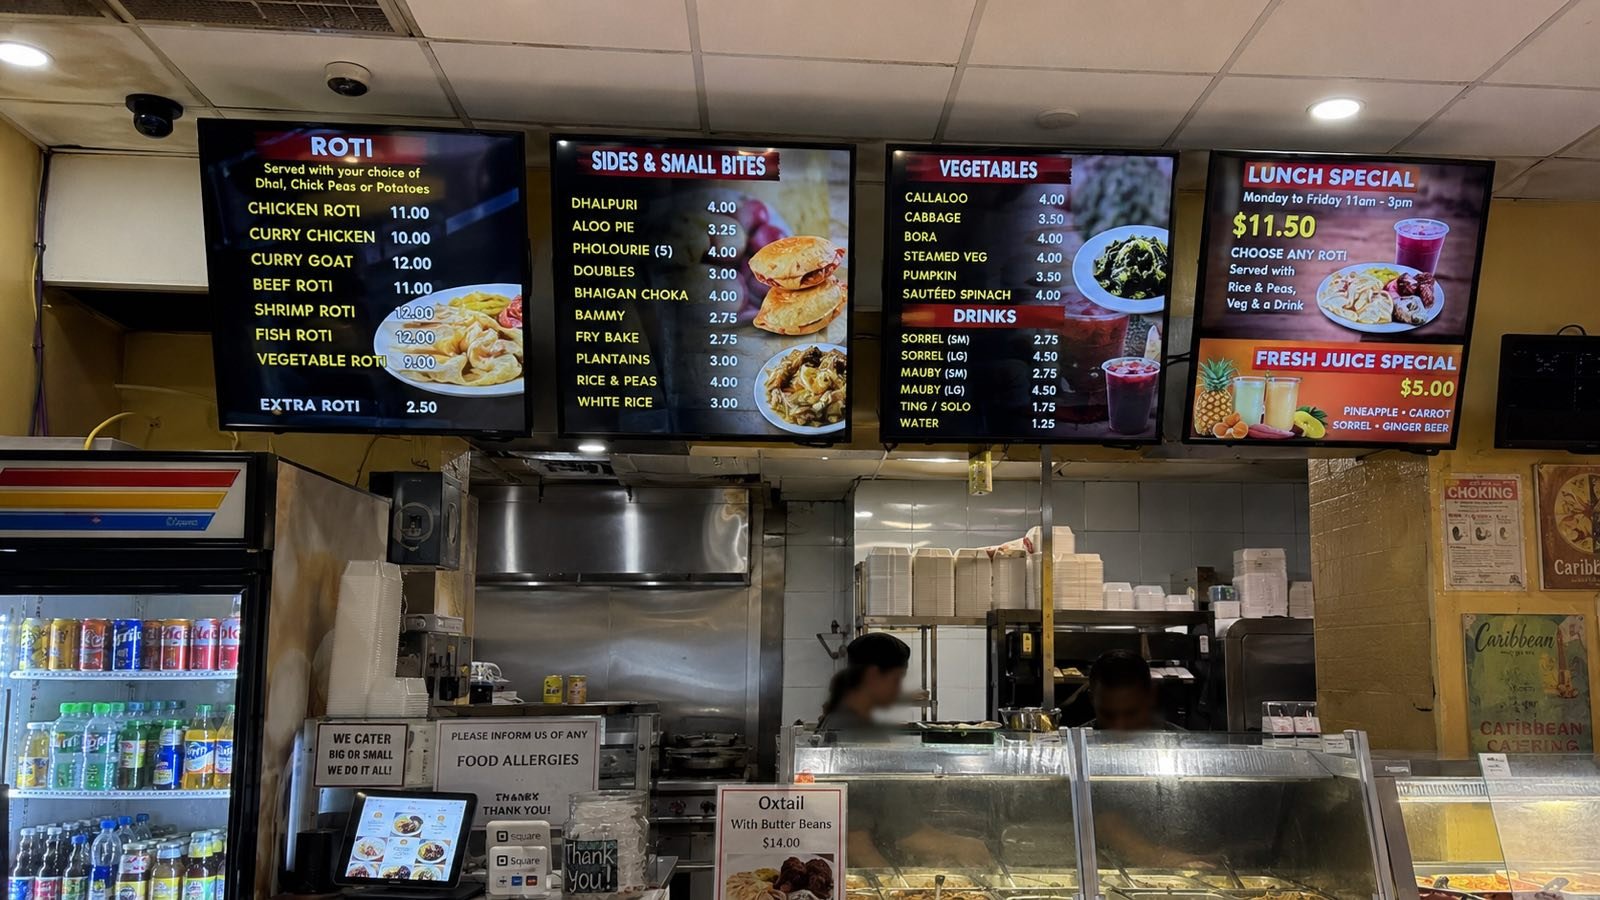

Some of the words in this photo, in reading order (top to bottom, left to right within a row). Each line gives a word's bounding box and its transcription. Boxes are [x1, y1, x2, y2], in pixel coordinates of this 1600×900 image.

[311, 136, 373, 157] ROTI
[591, 150, 638, 171] SIDES
[661, 153, 716, 175] SMALL
[721, 155, 766, 176] BITES
[939, 159, 1038, 179] VEGETABLES
[264, 163, 305, 175] Served
[309, 163, 334, 175] with
[337, 166, 364, 178] your
[367, 165, 405, 178] choice
[408, 166, 420, 178] of
[1248, 166, 1322, 185] LUNCH
[1328, 168, 1415, 187] SPECIAL
[255, 178, 287, 191] Dhal,
[290, 178, 324, 191] Chick
[328, 179, 356, 192] Peas
[360, 182, 373, 192] or
[377, 181, 430, 194] Potatoes
[571, 197, 638, 210] DHALPURI
[707, 201, 736, 213] 4.00
[905, 191, 968, 203] CALLALOO
[1039, 193, 1065, 205] 4.00
[1243, 192, 1288, 205] Monday
[1291, 193, 1304, 204] to
[1307, 193, 1342, 207] Friday
[1346, 195, 1376, 207] 11am
[1388, 196, 1413, 208] 3pm
[248, 201, 318, 216] CHICKEN
[323, 203, 361, 218] ROTI
[390, 205, 430, 220] 11.00
[904, 211, 961, 223] CABBAGE
[1038, 213, 1064, 224] 3.50
[572, 220, 611, 232] ALOO
[615, 221, 635, 232] PIE
[708, 224, 736, 235] 3.25
[1232, 211, 1316, 238] $11.50
[249, 227, 301, 242] CURRY
[307, 228, 376, 243] CHICKEN
[391, 231, 431, 245] 10.00
[904, 231, 937, 242] BORA
[1037, 233, 1063, 244] 4.00
[573, 242, 650, 256] PHOLOURIE
[654, 245, 673, 259] (5)
[708, 246, 737, 258] 4.00
[904, 250, 960, 262] STEAMED
[963, 251, 988, 262] VEG
[1036, 252, 1063, 263] 4.00
[1231, 247, 1283, 259] CHOOSE
[1287, 248, 1315, 260] ANY
[1318, 249, 1346, 261] ROTI
[251, 253, 303, 267] CURRY
[308, 254, 354, 268] GOAT
[392, 256, 432, 270] 12.00
[574, 265, 635, 277] DOUBLES
[708, 268, 737, 279] 3.00
[903, 270, 957, 281] PUMPKIN
[1036, 271, 1062, 282] 3.50
[1229, 264, 1268, 275] Served
[1271, 265, 1295, 276] with
[253, 278, 291, 291] BEEF
[296, 279, 333, 292] ROTI
[394, 281, 433, 295] 11.00
[902, 285, 956, 300] SAUTÉED
[960, 289, 1011, 300] SPINACH
[1035, 290, 1061, 300] 4.00
[1228, 282, 1251, 293] Rice
[1266, 283, 1297, 295] Peas,
[574, 287, 637, 299] BHAIGAN
[641, 289, 689, 301] CHOKA
[709, 290, 737, 302] 4.00
[254, 303, 314, 317] SHRIMP
[319, 304, 355, 318] ROTI
[395, 306, 434, 320] 12.00
[1227, 298, 1248, 311] Veg
[1274, 299, 1304, 310] Drink
[575, 309, 625, 321] BAMMY
[709, 312, 737, 323] 2.75
[953, 308, 1017, 323] DRINKS
[255, 328, 291, 341] FISH
[296, 329, 332, 342] ROTI
[395, 330, 435, 344] 12.00
[576, 331, 600, 342] FRY
[605, 332, 640, 343] BAKE
[709, 333, 737, 344] 2.75
[901, 333, 944, 344] SORREL
[947, 334, 970, 345] (SM)
[1033, 334, 1059, 345] 2.75
[257, 352, 346, 366] VEGETABLE
[351, 354, 387, 368] ROTI
[403, 355, 436, 369] 9.00
[576, 353, 651, 365] PLANTAINS
[710, 355, 738, 366] 3.00
[901, 350, 944, 361] SORREL
[947, 351, 968, 363] (LG)
[1032, 351, 1058, 361] 4.50
[1256, 350, 1317, 367] FRESH
[1321, 351, 1375, 368] JUICE
[1380, 353, 1457, 370] SPECIAL
[900, 367, 941, 378] MAUBY
[945, 368, 967, 379] (SM)
[1032, 368, 1057, 378] 2.75
[577, 375, 606, 386] RICE
[624, 375, 657, 387] PEAS
[710, 376, 738, 387] 4.00
[1400, 378, 1455, 397] $5.00
[900, 384, 941, 395] MAUBY
[944, 385, 965, 396] (LG)
[1032, 385, 1057, 395] 4.50
[260, 398, 316, 411] EXTRA
[321, 399, 360, 412] ROTI
[406, 400, 437, 414] 2.50
[577, 396, 620, 407] WHITE
[624, 396, 653, 408] RICE
[710, 397, 738, 408] 3.00
[900, 401, 927, 411] TING
[940, 402, 971, 412] SOLO
[1032, 402, 1056, 412] 1.75
[1343, 405, 1398, 417] PINEAPPLE
[1409, 408, 1451, 418] CARROT
[900, 417, 939, 428] WATER
[1032, 419, 1055, 429] 1.25
[1332, 420, 1372, 430] SORREL
[1382, 421, 1422, 431] GINGER
[1424, 422, 1449, 432] BEER
[1447, 487, 1513, 499] CHOKING
[1475, 622, 1555, 652] Caribbean
[333, 733, 352, 744] WE
[354, 733, 391, 745] CATER
[451, 731, 488, 741] PLEASE
[491, 730, 531, 740] INFORM
[534, 730, 548, 740] US
[550, 730, 563, 739] OF
[566, 730, 588, 739] ANY
[329, 749, 345, 759] BIG
[347, 749, 360, 759] OR
[362, 749, 393, 760] SMALL
[457, 755, 498, 767] FOOD
[502, 754, 579, 767] ALLERGIES
[327, 765, 343, 775] WE
[345, 765, 358, 775] DO
[371, 765, 392, 775] ALL!
[483, 805, 520, 816] THANK
[523, 804, 550, 815] YOU!
[759, 796, 804, 810] Oxtail
[731, 819, 758, 830] With
[761, 819, 796, 829] Butter
[799, 819, 832, 829] Beans
[763, 837, 800, 849] $14.00
[564, 843, 614, 865] Thank
[568, 866, 611, 893] you!
